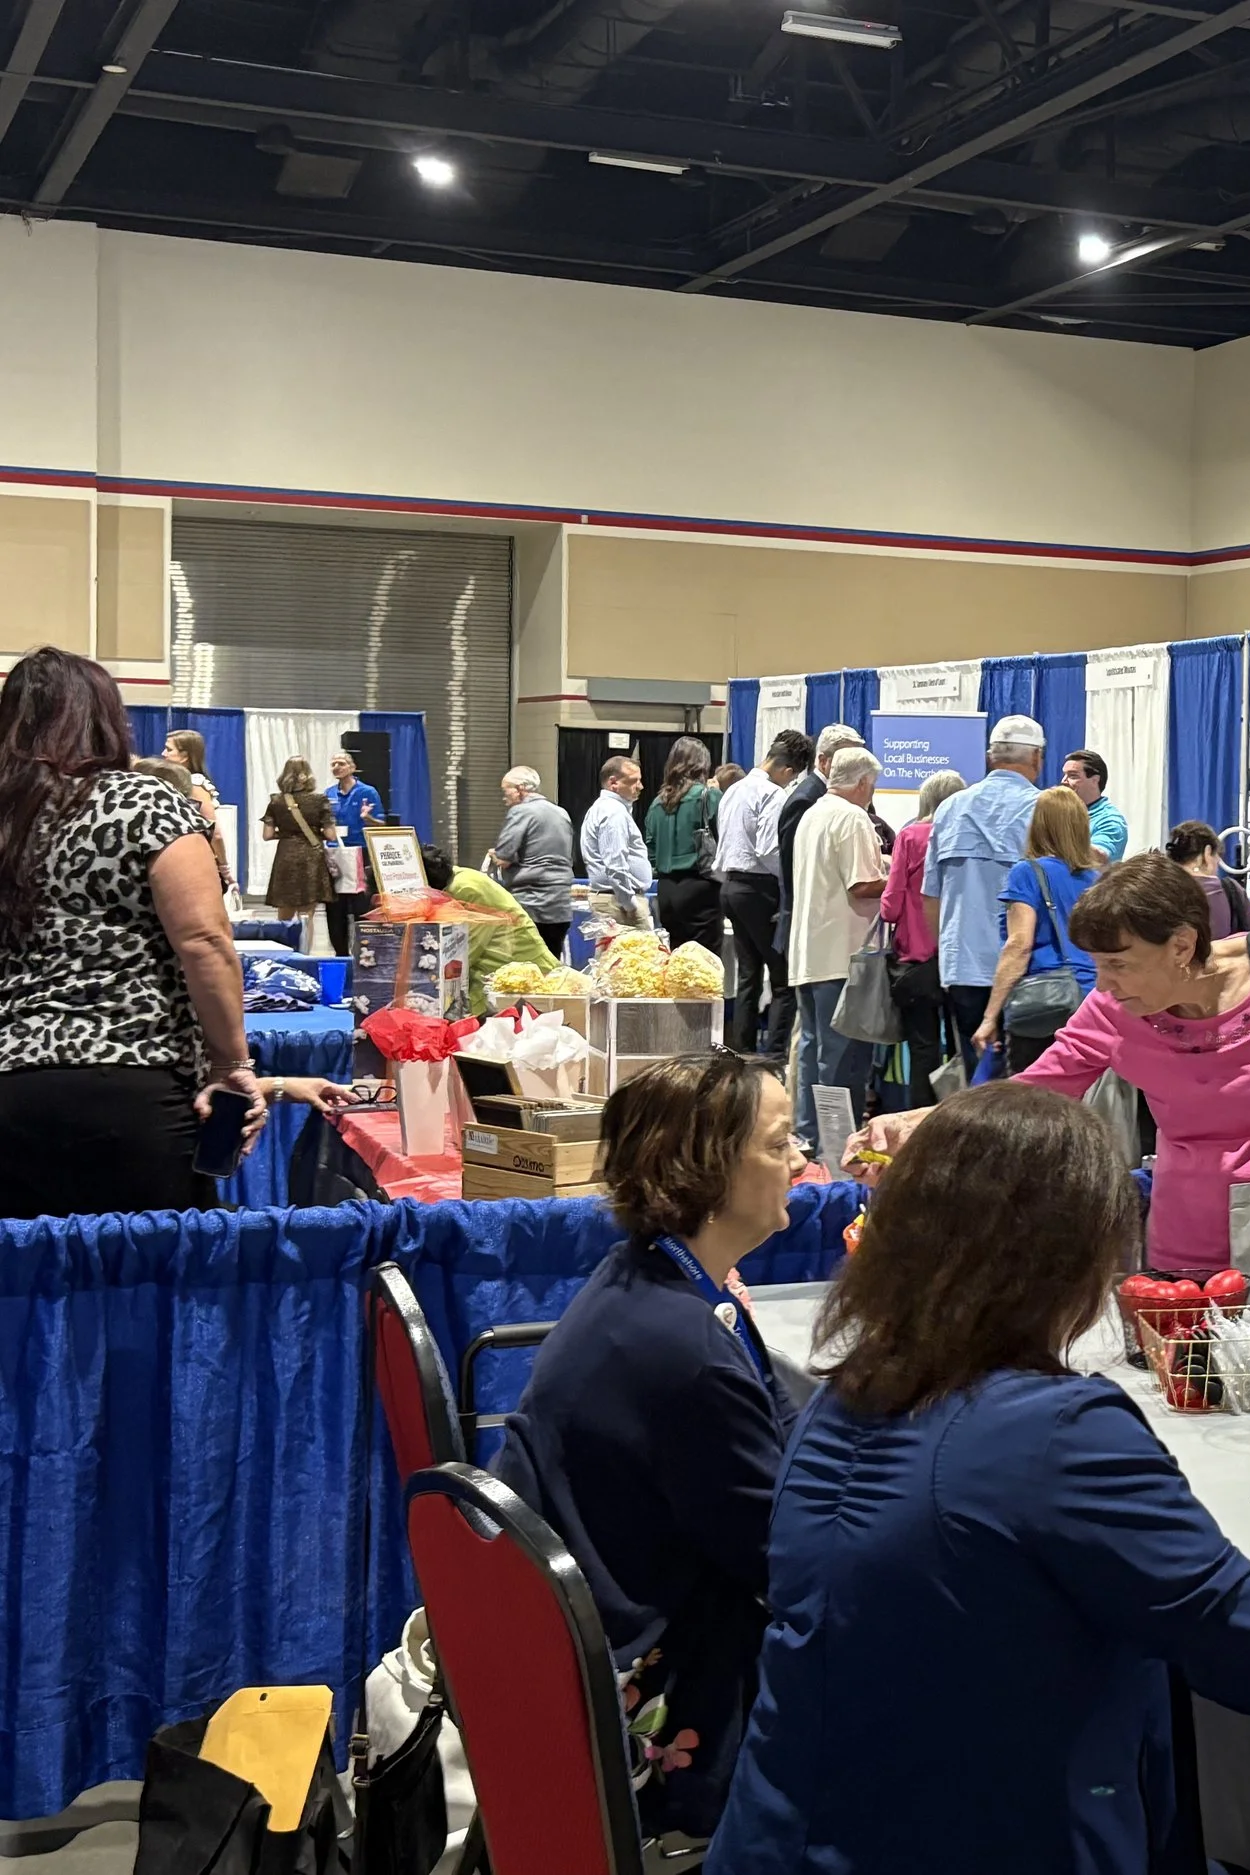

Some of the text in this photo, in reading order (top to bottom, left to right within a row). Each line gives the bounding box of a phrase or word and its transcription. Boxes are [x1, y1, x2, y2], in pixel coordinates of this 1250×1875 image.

[883, 738, 930, 751] Supporting
[884, 753, 950, 764] Local Businesses
[884, 767, 895, 777] On
[897, 768, 912, 778] The
